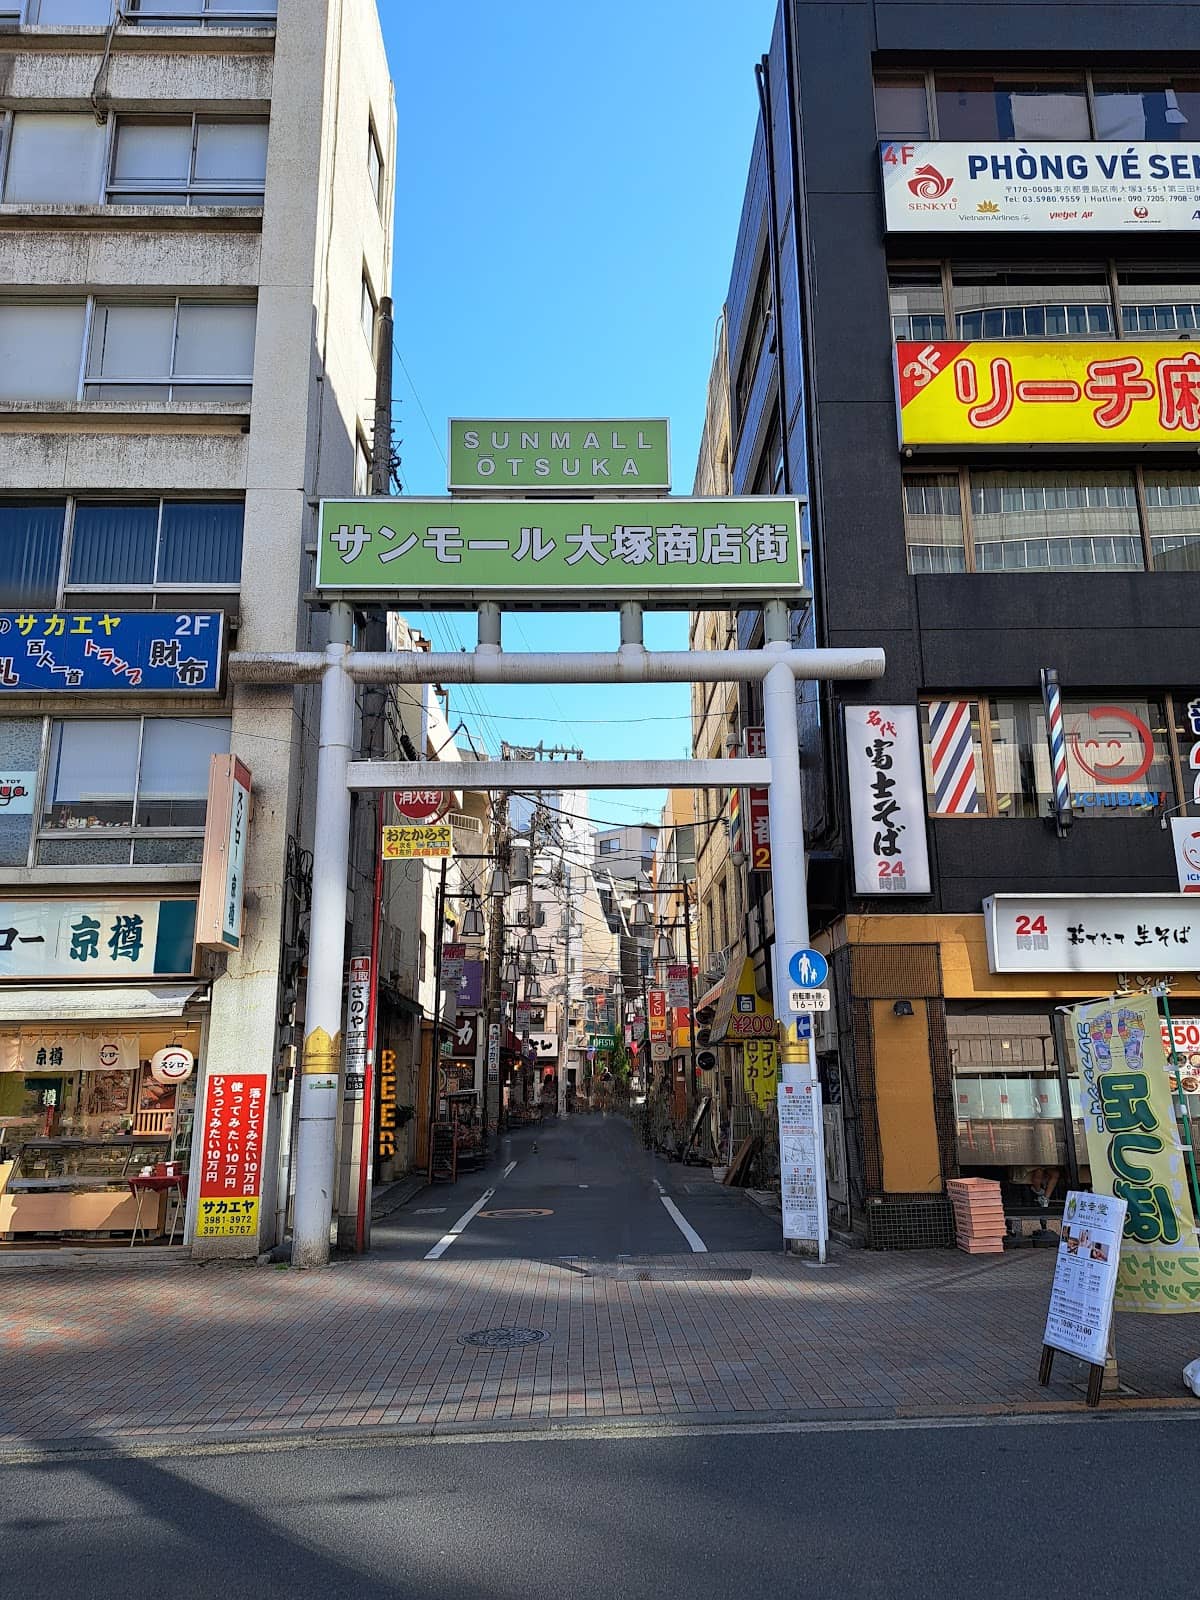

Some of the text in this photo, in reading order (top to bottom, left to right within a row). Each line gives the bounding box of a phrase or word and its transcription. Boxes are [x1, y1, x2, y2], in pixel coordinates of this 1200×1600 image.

[883, 145, 915, 166] 4F
[967, 148, 1088, 180] PHÒNG
[1095, 148, 1141, 180] VÉ
[903, 345, 942, 388] 3F
[463, 431, 653, 450] SUNMALL
[330, 523, 789, 566] サンモール 大塚商店街
[14, 613, 122, 637] サカエヤ
[174, 614, 212, 636] 2F
[27, 639, 85, 686] 百人一首
[84, 638, 143, 686] トランプ
[150, 639, 210, 686] 財布
[865, 739, 907, 857] 富士そば
[386, 827, 451, 842] おたからや
[877, 861, 906, 878] 24
[69, 914, 145, 962] 京樽
[1015, 916, 1048, 935] 24
[350, 984, 365, 1029] さのや
[795, 1000, 825, 1009] 16-19
[732, 1015, 775, 1034] ¥200
[160, 1060, 191, 1070] スシロー
[762, 1041, 774, 1078] コイン
[379, 1048, 398, 1156] BEER
[205, 1076, 225, 1184] ひろってみたい10万円
[224, 1081, 244, 1189] 使ってみたい10万円
[242, 1087, 262, 1195] 落としてみたい10万円
[202, 1200, 255, 1215] サカエヤ
[204, 1215, 252, 1224] 3981-3972
[203, 1225, 251, 1235] 3971-5767
